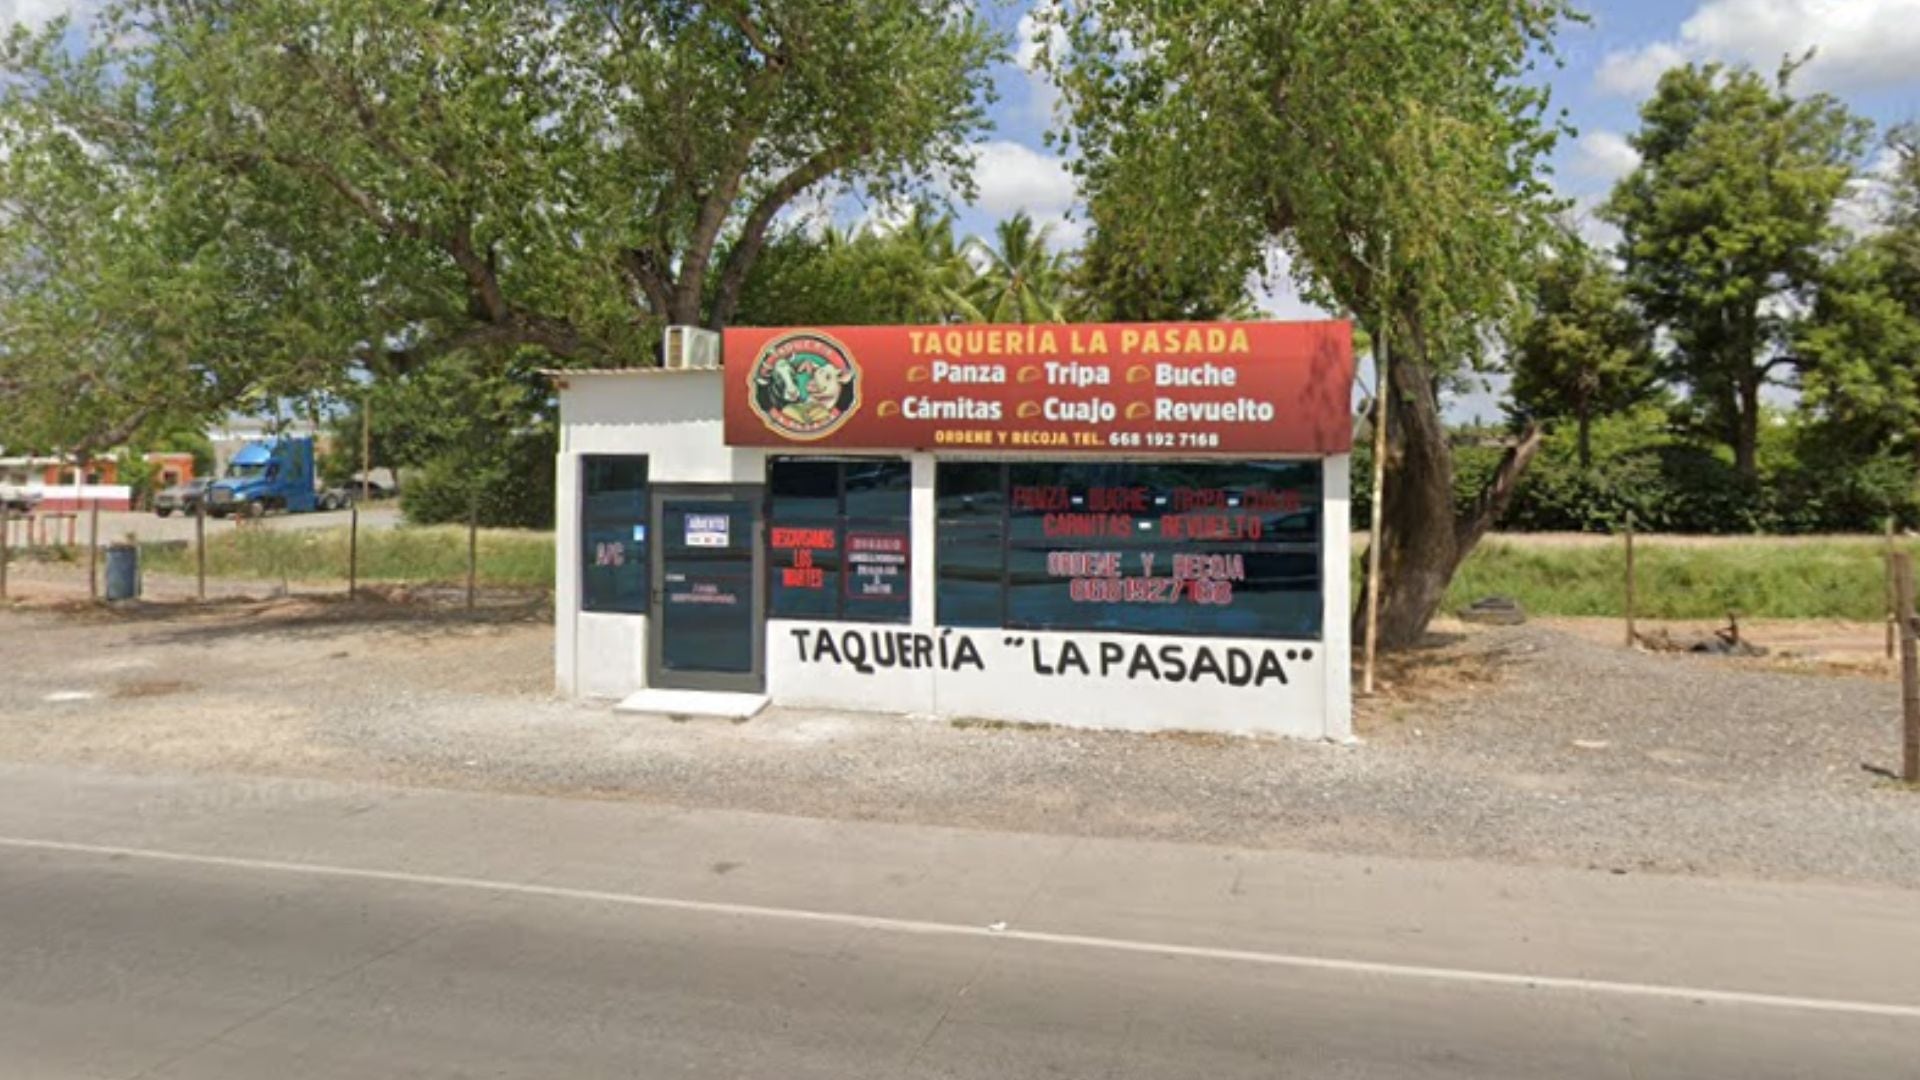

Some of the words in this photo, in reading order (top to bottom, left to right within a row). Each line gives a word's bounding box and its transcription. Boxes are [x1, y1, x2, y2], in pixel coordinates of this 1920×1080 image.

[909, 324, 1058, 357] TAQUERÍA
[1071, 329, 1108, 353] LA
[1121, 328, 1250, 353] PASADA
[932, 361, 1006, 384] Panza
[1044, 361, 1110, 387] Tripa
[1155, 363, 1237, 386] Buche
[903, 396, 1002, 420] Cárnitas
[1043, 398, 1116, 424] Cuajo
[1155, 398, 1274, 422] Revuelto
[935, 430, 993, 444] ORDENE
[998, 431, 1007, 444] Y
[1011, 431, 1069, 445] RECOJA
[1073, 432, 1105, 446] TEL.
[1109, 432, 1140, 446] 668
[1145, 432, 1174, 446] 192
[1179, 432, 1220, 446] 7168
[1042, 512, 1134, 539] CARNITAS
[1159, 514, 1263, 540] REVUELTO
[1140, 551, 1155, 577] Y
[790, 628, 985, 674] TAQUERÍA
